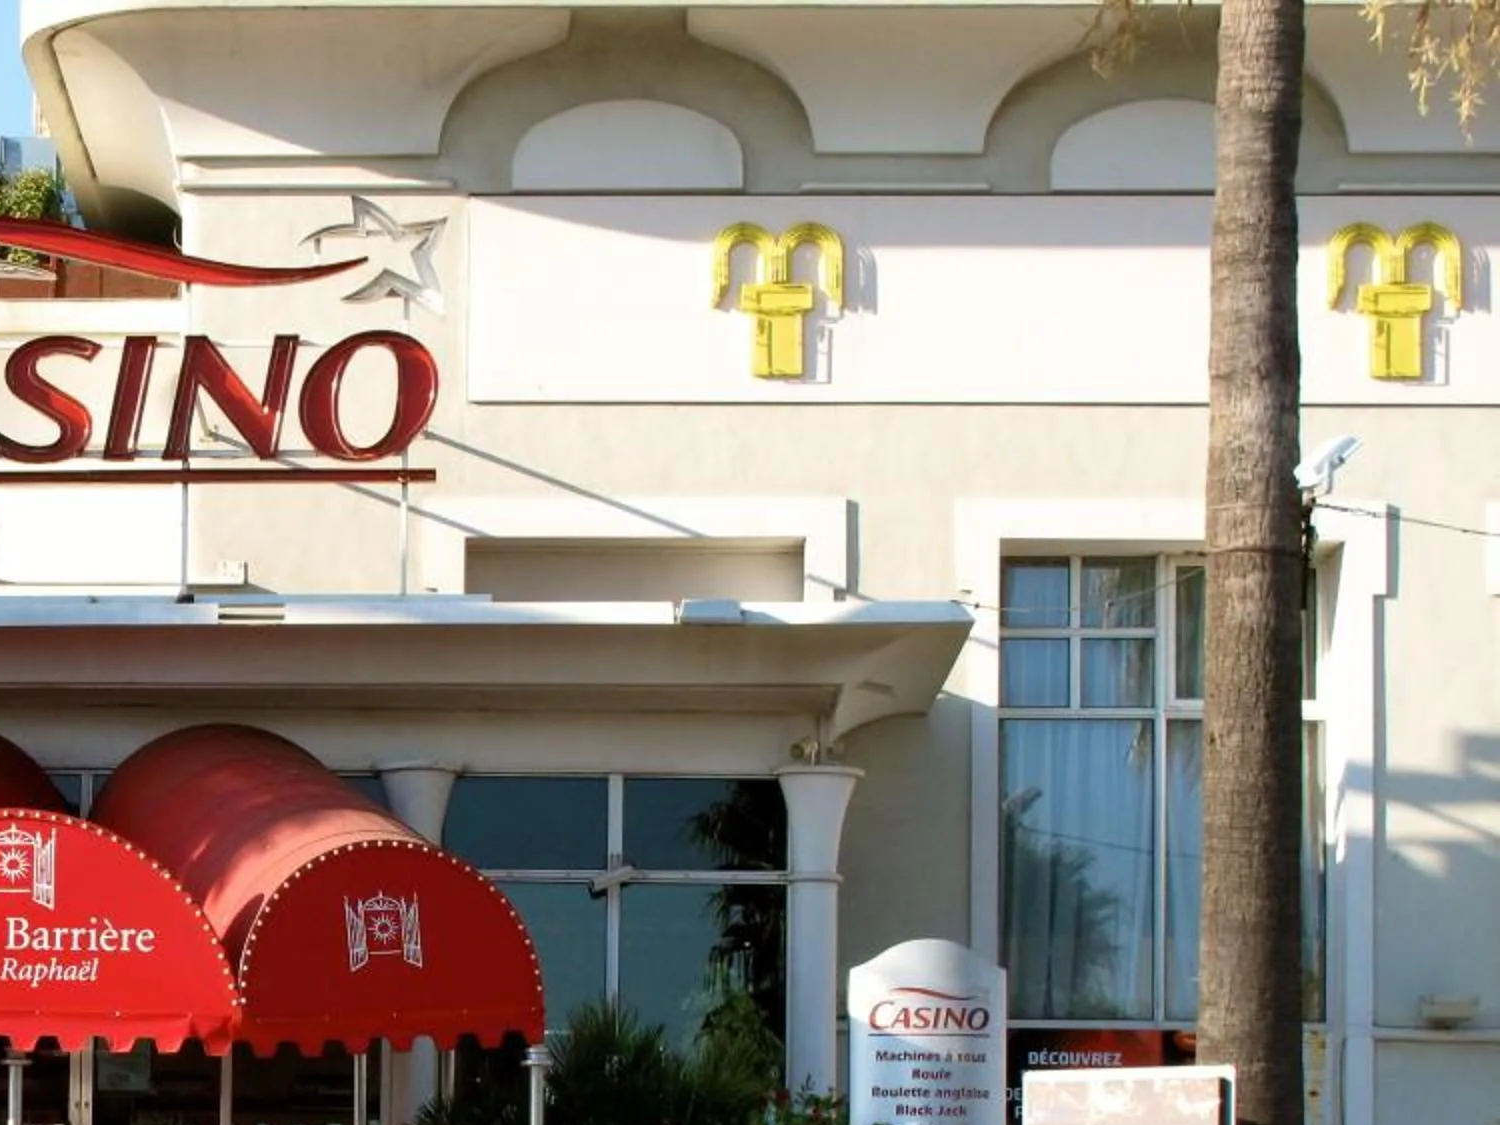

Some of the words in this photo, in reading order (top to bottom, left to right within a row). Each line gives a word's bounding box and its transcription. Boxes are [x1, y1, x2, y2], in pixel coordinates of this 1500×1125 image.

[5, 916, 157, 953] Barrière
[868, 1000, 991, 1032] CASINO
[875, 1050, 941, 1064] Machines
[957, 1053, 987, 1064] sous
[1027, 1048, 1124, 1067] DÉCOUVREZ
[871, 1086, 931, 1099] Roulette
[934, 1086, 991, 1101] anglaise
[895, 1104, 933, 1117] Black
[937, 1104, 968, 1117] Jack
